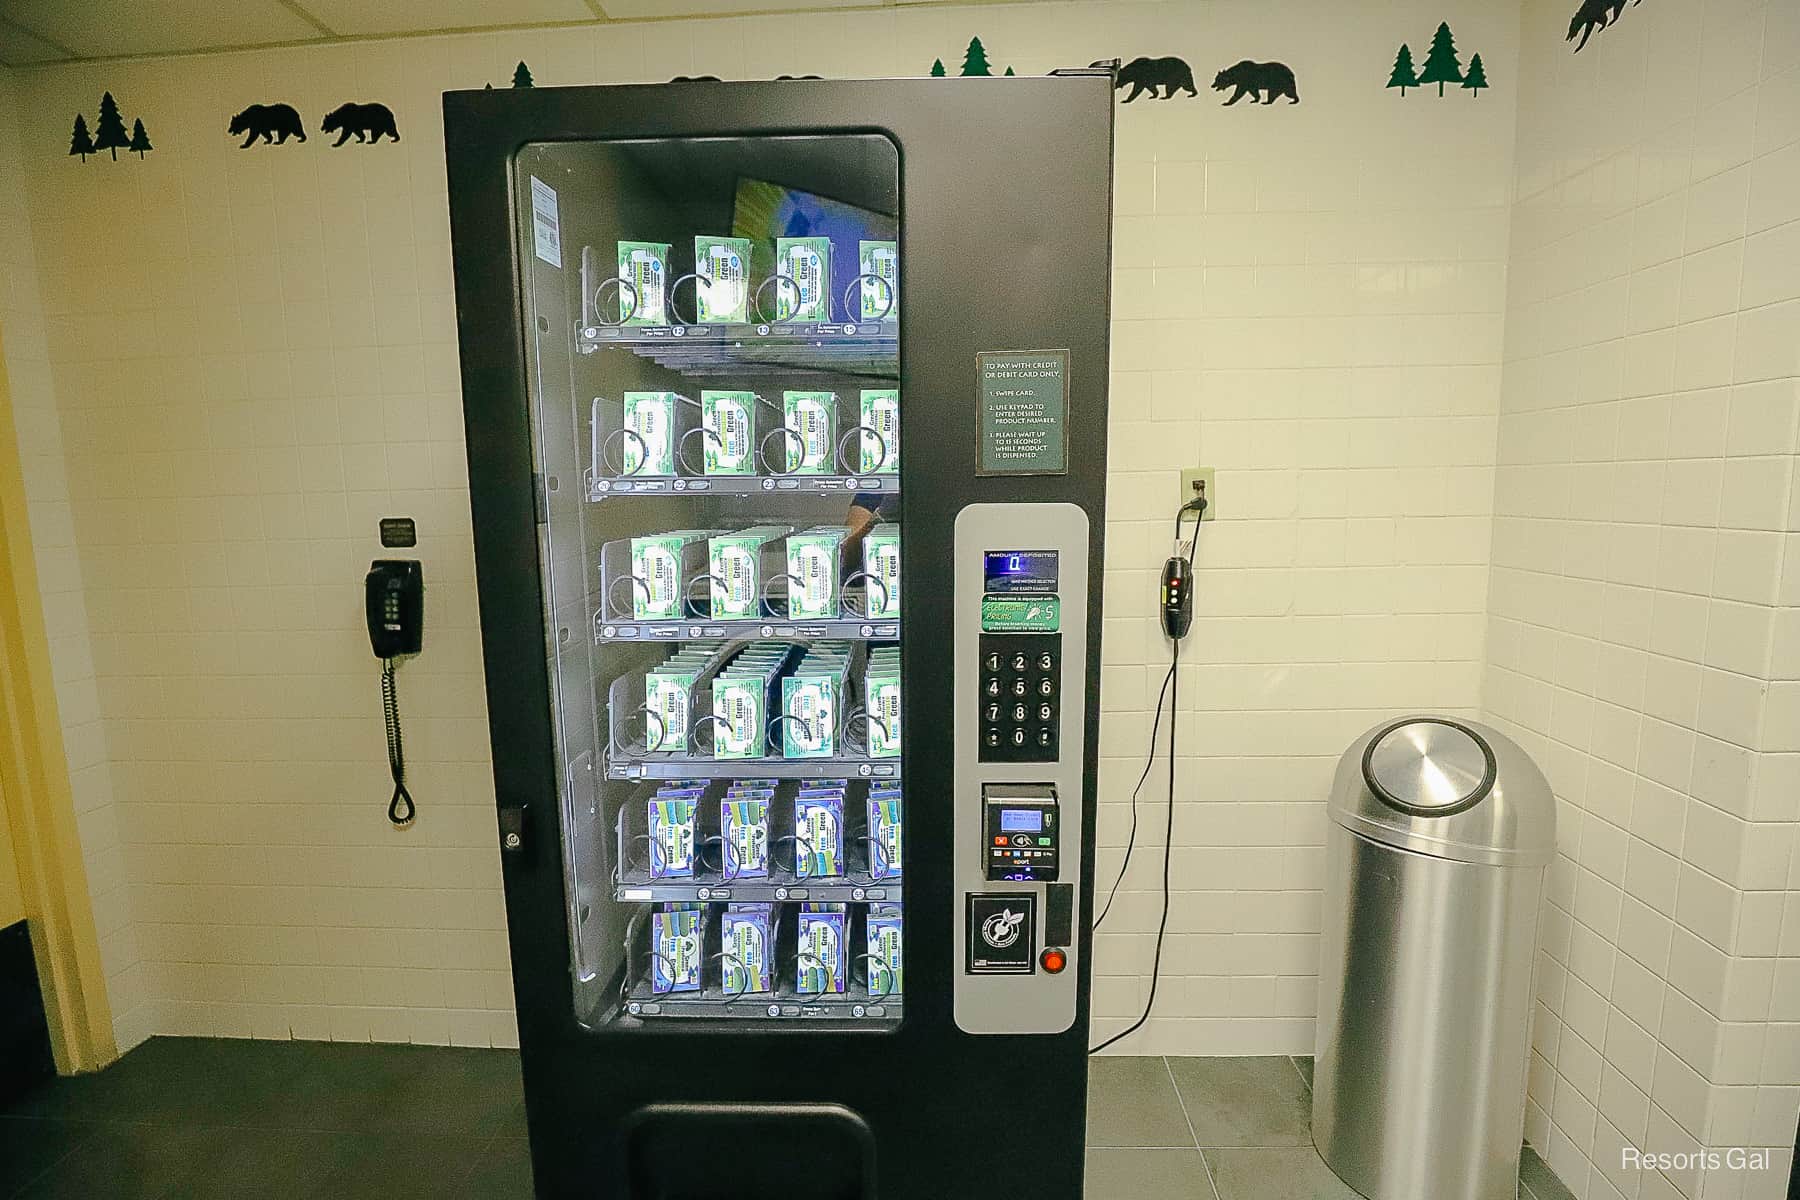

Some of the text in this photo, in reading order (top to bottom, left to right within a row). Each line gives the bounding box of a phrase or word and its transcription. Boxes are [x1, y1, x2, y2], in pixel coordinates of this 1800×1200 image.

[990, 656, 1051, 668] 1 2 3
[990, 681, 1051, 694] 4 5 6
[990, 706, 1050, 719] 7 8 9
[1015, 732, 1023, 743] 0
